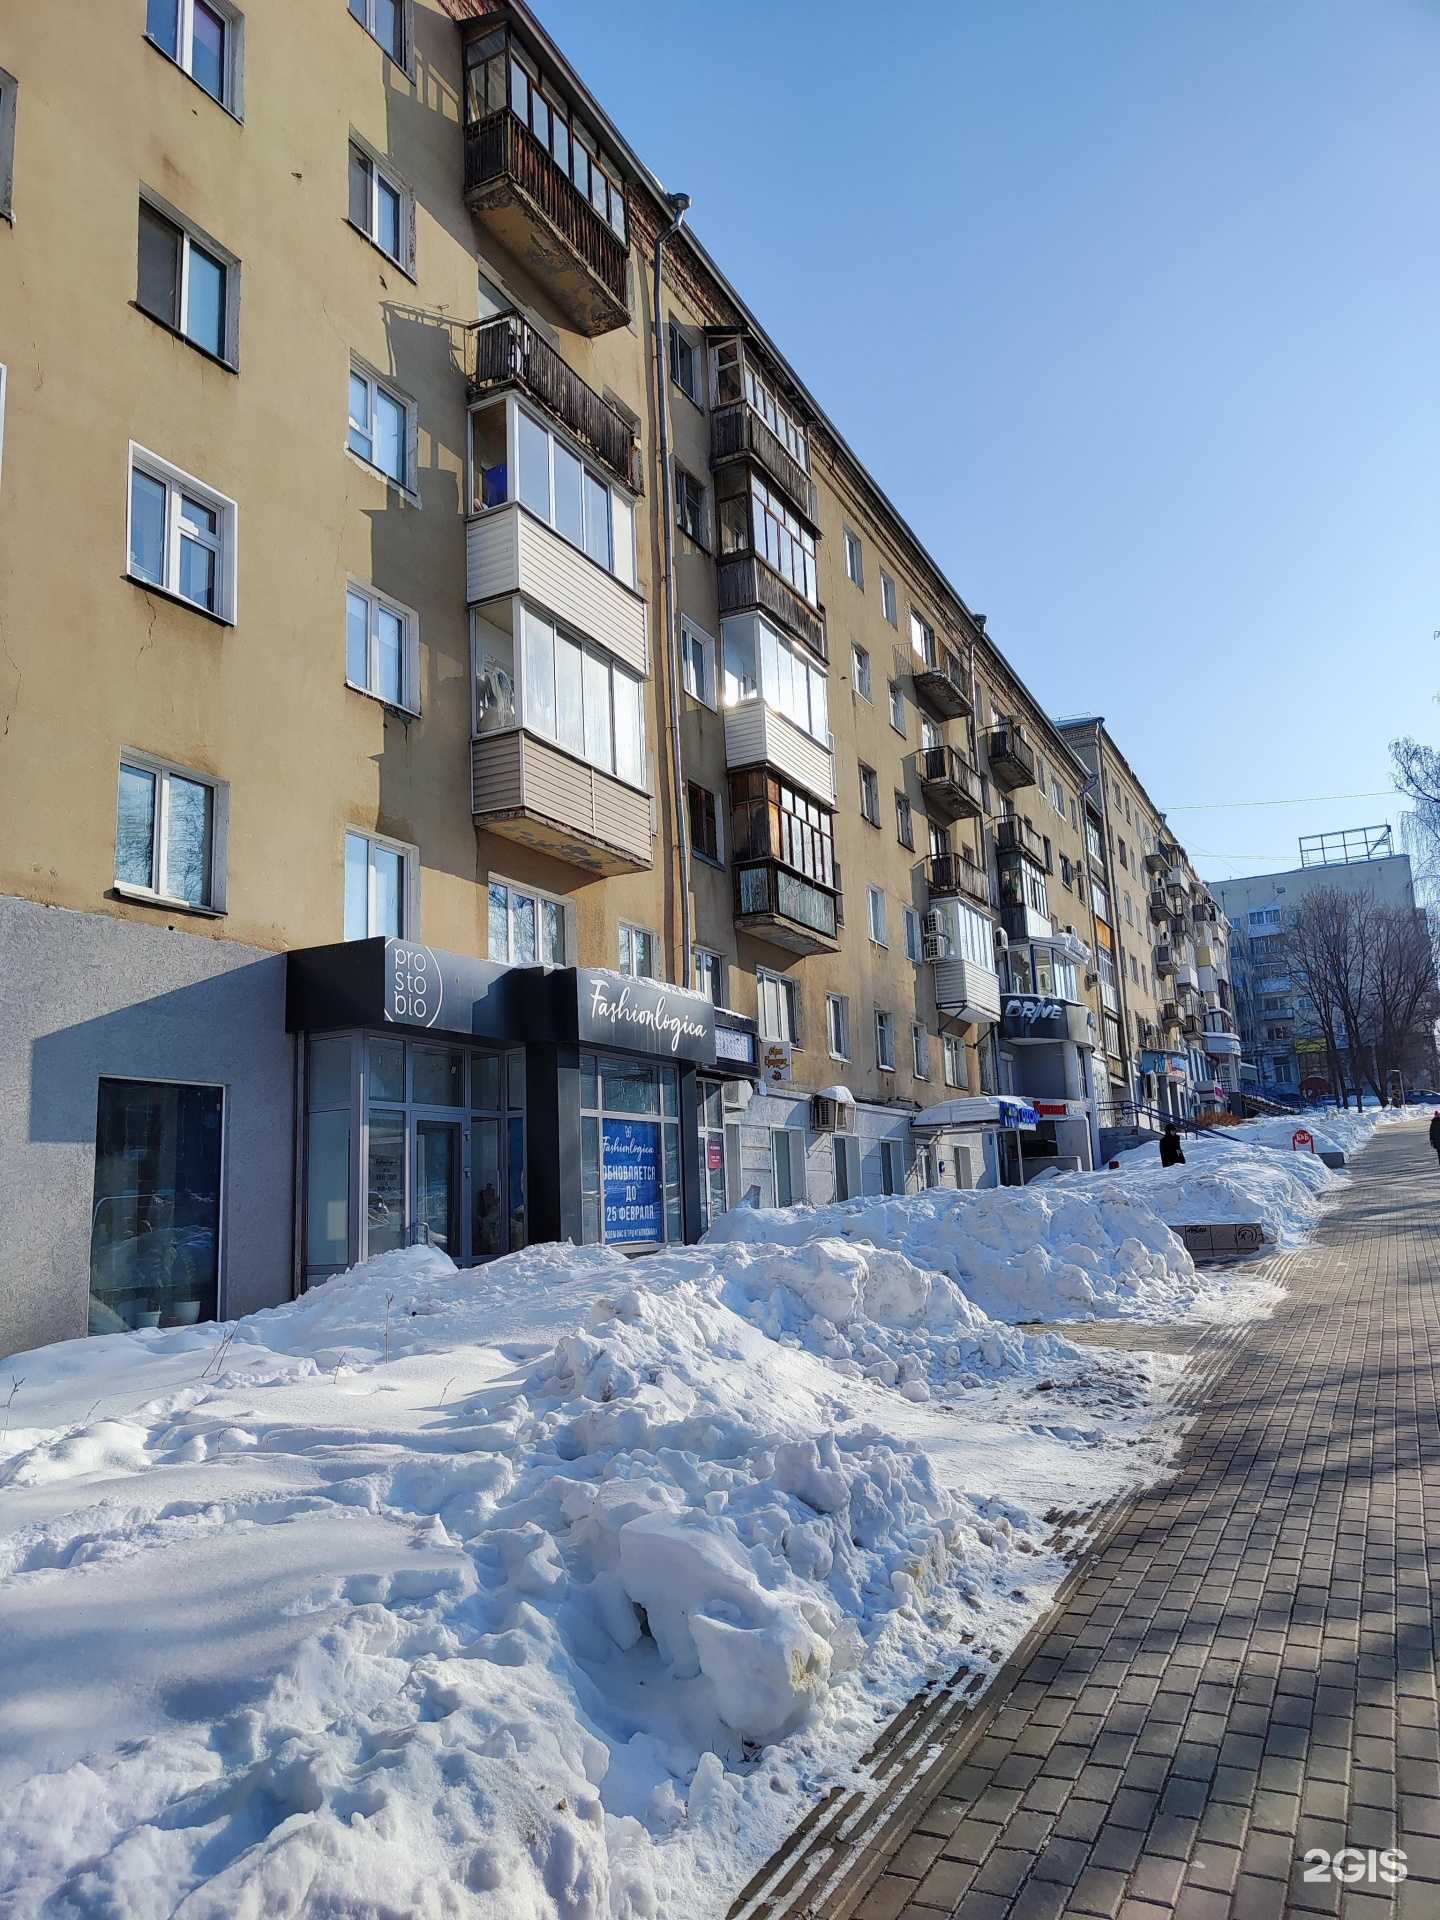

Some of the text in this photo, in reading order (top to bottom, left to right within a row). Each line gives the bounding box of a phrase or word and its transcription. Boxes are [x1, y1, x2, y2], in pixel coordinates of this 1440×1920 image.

[394, 948, 427, 972] pro
[394, 971, 427, 995] sto
[394, 991, 427, 1018] bio
[590, 979, 707, 1052] Fashionlogica
[1005, 998, 1063, 1024] DRIVE
[603, 1136, 655, 1162] Fashionlogica
[625, 1185, 637, 1202] ДО
[607, 1204, 654, 1222] 25 ФЕВРАЛЯ
